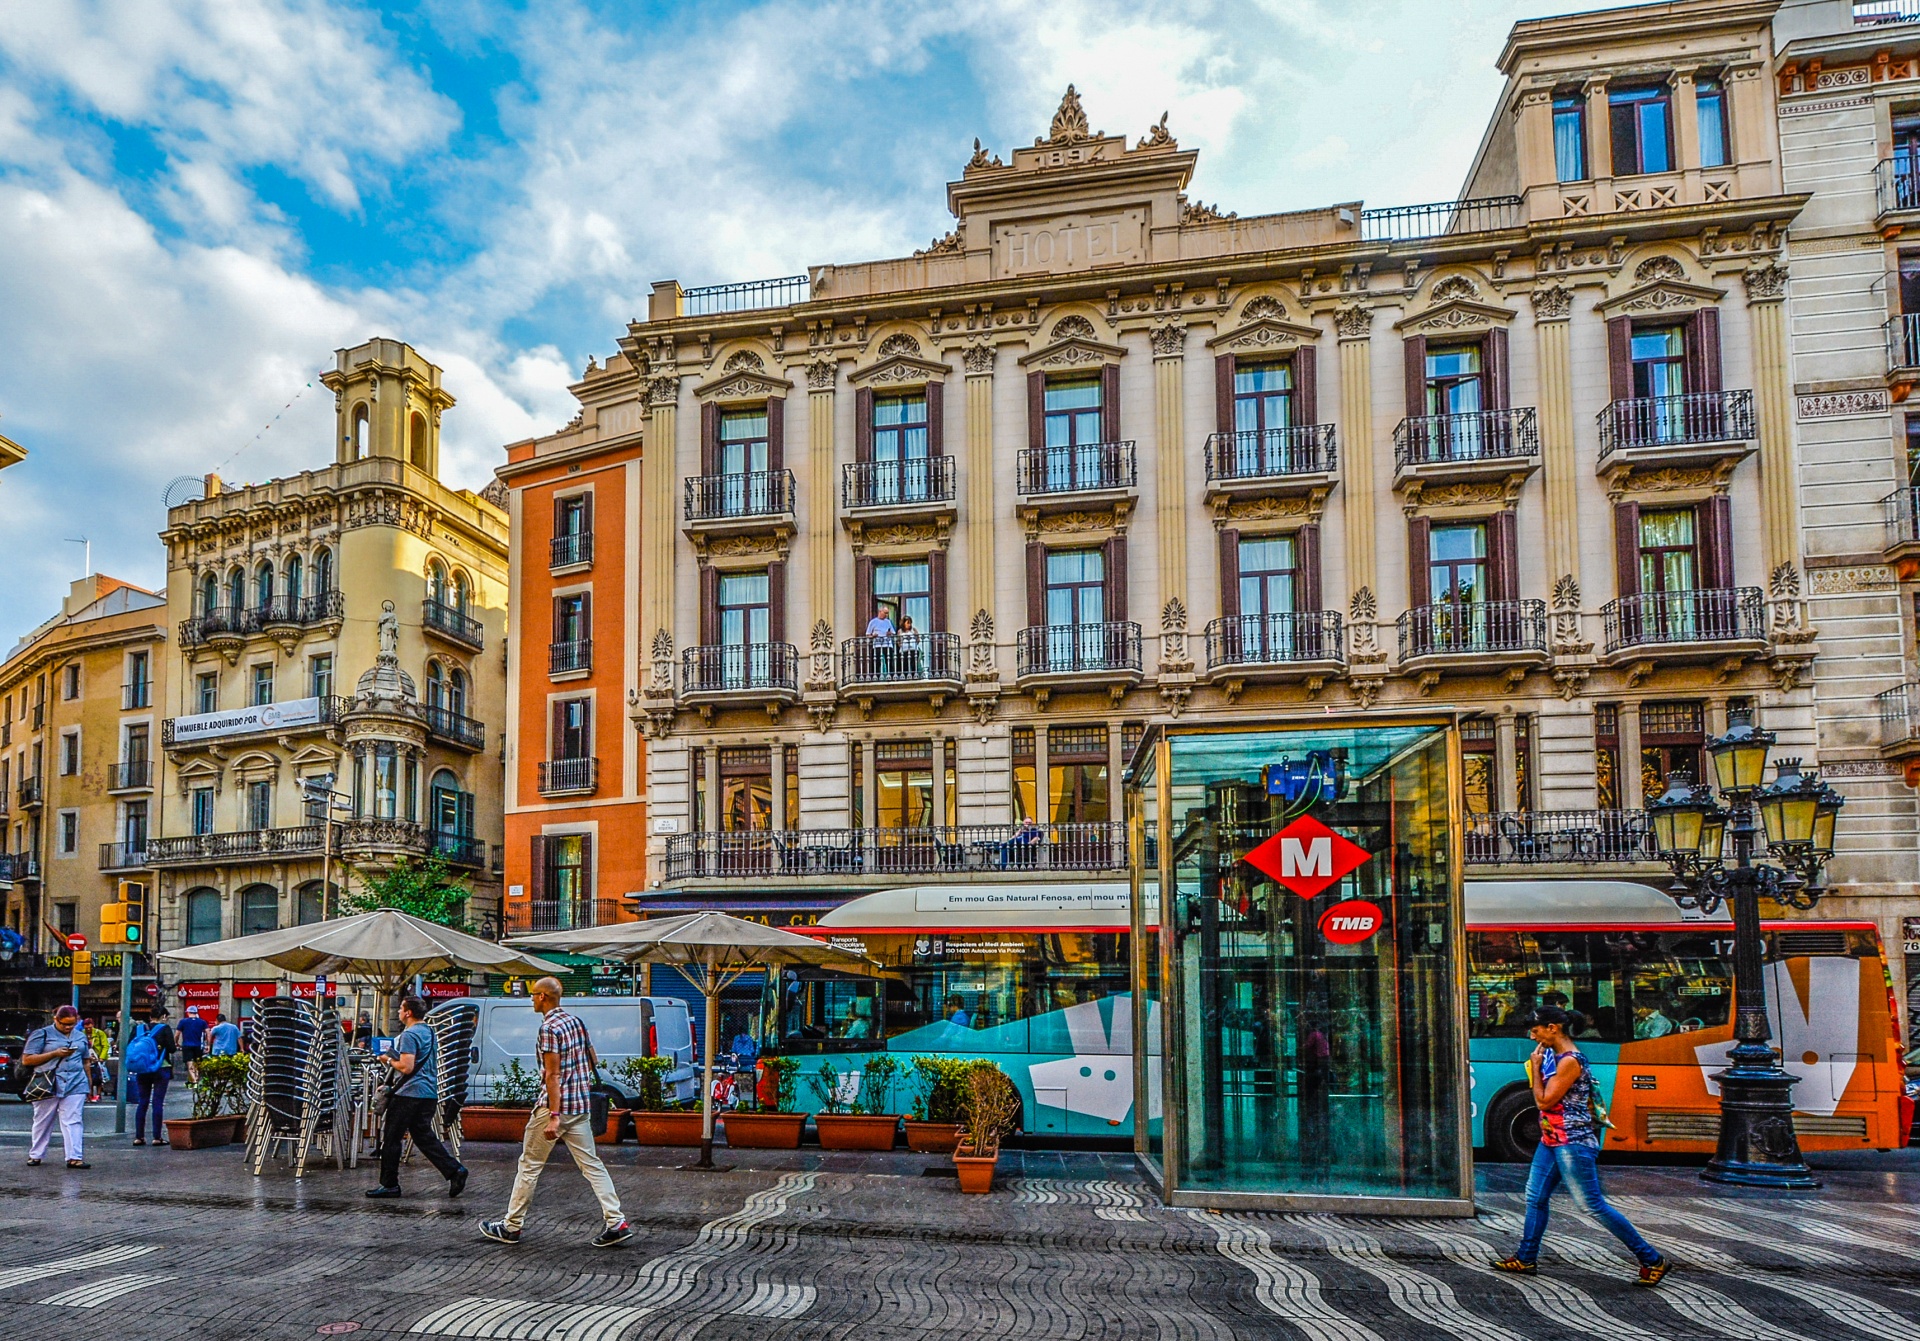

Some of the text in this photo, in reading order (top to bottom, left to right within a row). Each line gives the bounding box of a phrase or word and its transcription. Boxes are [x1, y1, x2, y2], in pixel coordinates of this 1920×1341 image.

[1035, 145, 1105, 168] 1894
[1006, 221, 1130, 268] HOTEL
[176, 723, 208, 734] INMUEBLE
[209, 717, 243, 729] ADQUIRIDO
[243, 715, 258, 724] POR
[1281, 837, 1332, 877] M
[1006, 894, 1039, 902] Natural
[1331, 917, 1374, 930] TMB
[1710, 939, 1767, 955] 17
[99, 955, 122, 966] PAR
[188, 988, 219, 997] Santander
[432, 987, 464, 997] Santander
